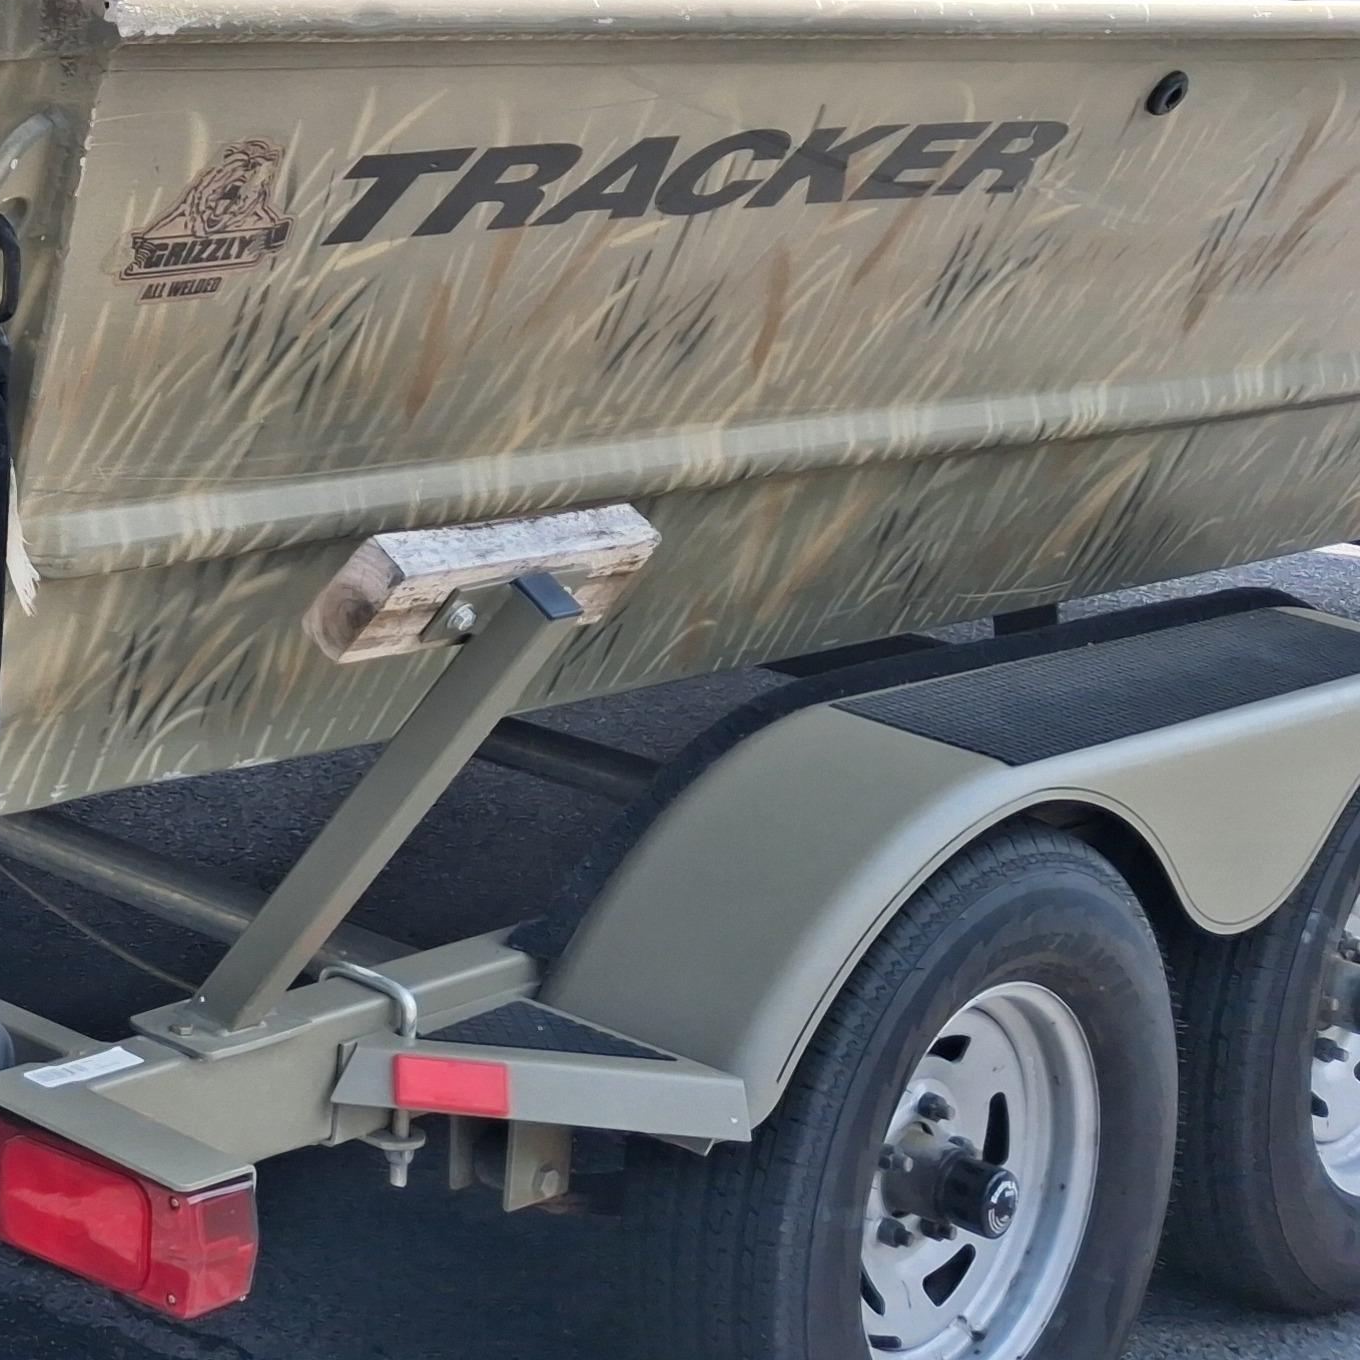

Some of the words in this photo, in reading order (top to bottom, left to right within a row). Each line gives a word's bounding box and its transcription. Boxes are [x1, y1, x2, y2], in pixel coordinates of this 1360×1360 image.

[318, 119, 1070, 246] TRACKER
[143, 236, 259, 269] GRIZZLY
[167, 276, 223, 298] WELDED
